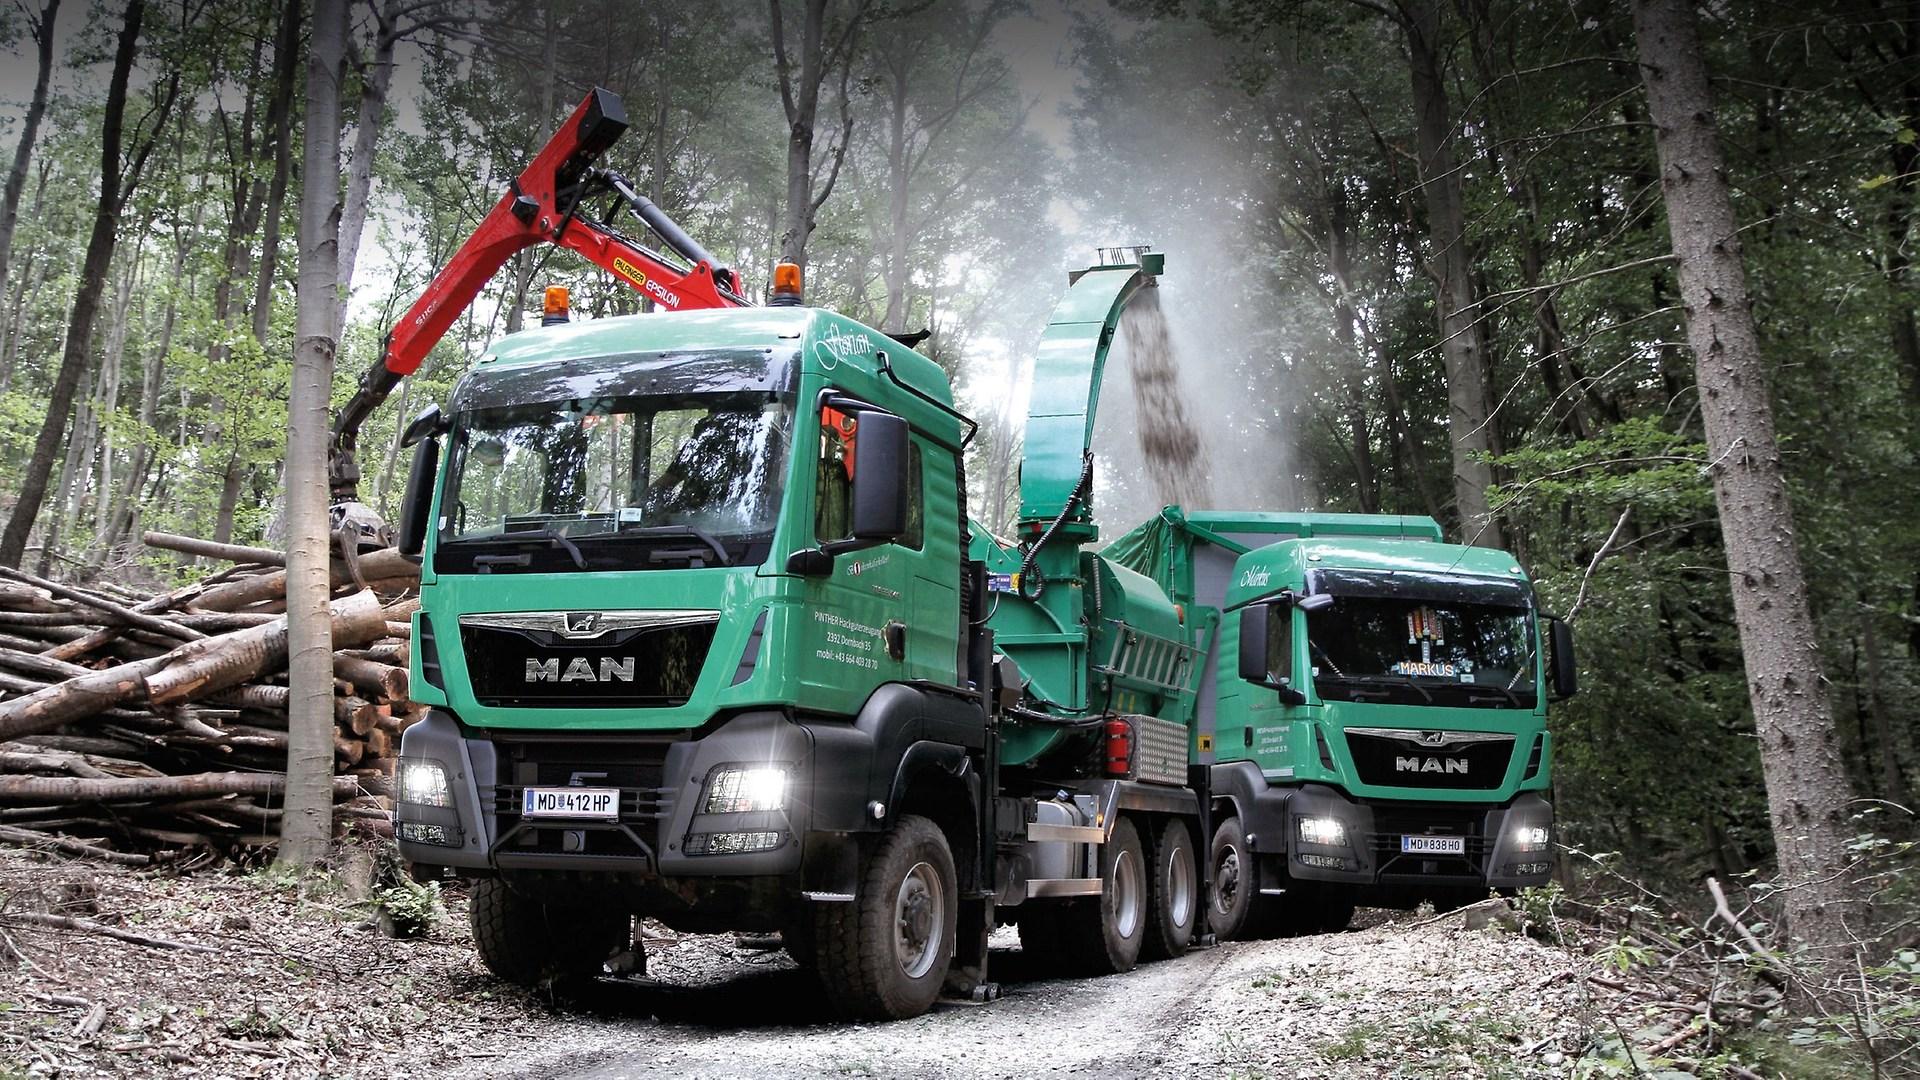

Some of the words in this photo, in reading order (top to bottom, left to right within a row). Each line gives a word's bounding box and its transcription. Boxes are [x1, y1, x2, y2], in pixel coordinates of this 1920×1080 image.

[614, 258, 645, 284] PALFINGER
[645, 279, 681, 308] EPSILON
[814, 322, 874, 372] Florian
[814, 611, 839, 627] PINTHER
[827, 632, 840, 645] 2392
[840, 634, 865, 650] Dornbach
[864, 640, 872, 652] 35
[525, 657, 635, 682] MAN
[834, 652, 845, 663] +43
[845, 653, 855, 665] 664
[864, 658, 872, 669] 28
[872, 660, 879, 670] 70
[1400, 661, 1455, 677] MARKUS
[1395, 756, 1469, 774] MAN
[538, 793, 556, 810] MD
[567, 794, 591, 811] 412
[593, 794, 611, 811] HP
[1410, 838, 1423, 850] MD
[1429, 839, 1447, 851] 838
